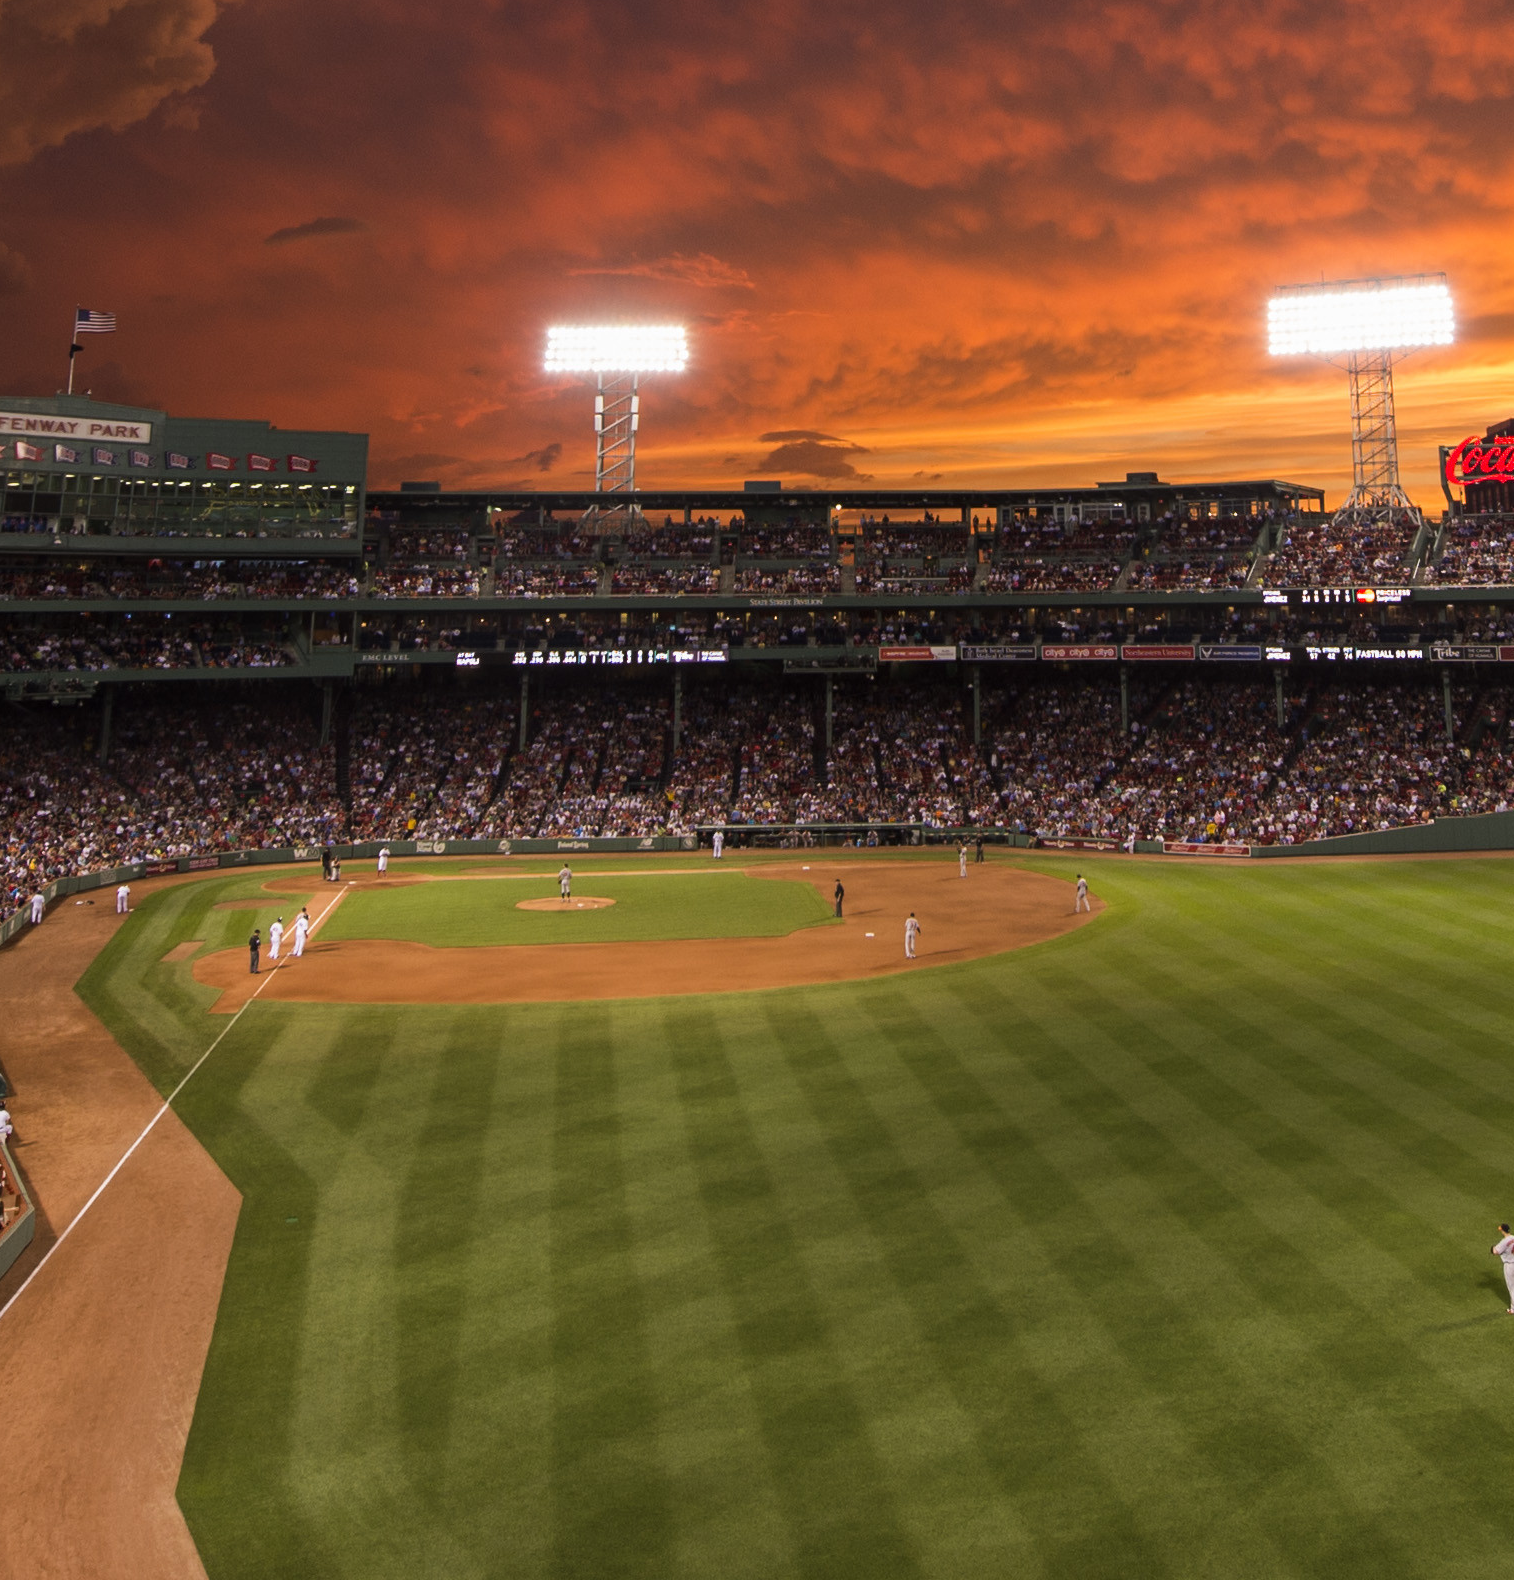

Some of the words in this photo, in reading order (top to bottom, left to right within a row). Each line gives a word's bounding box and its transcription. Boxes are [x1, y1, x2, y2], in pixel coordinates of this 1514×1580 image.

[91, 423, 141, 439] PARK
[1356, 649, 1394, 659] FASTBALL
[1433, 647, 1460, 660] Tribe
